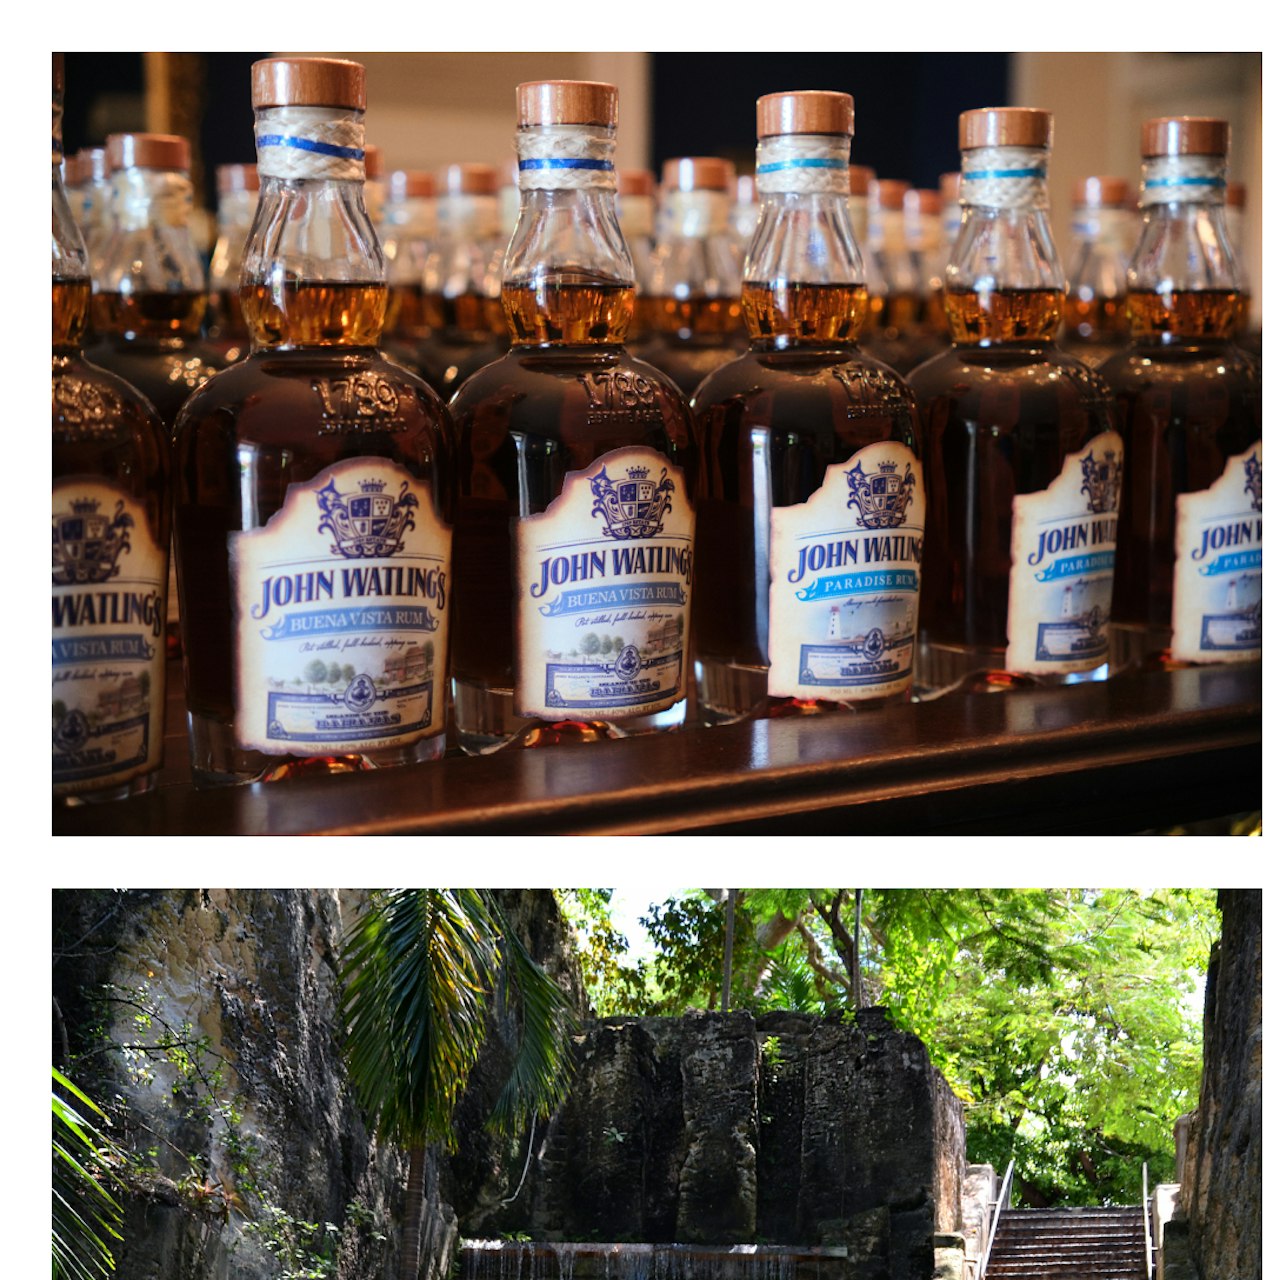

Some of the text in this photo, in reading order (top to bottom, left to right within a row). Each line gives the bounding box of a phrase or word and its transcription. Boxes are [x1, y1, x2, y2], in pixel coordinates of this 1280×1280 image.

[787, 535, 922, 583] JOHN WATLIN
[1027, 523, 1089, 566] JOHN
[1191, 520, 1253, 561] JOHN
[251, 565, 447, 620] JOHN WATLING'S
[530, 545, 692, 598] JOHN WATLING'S
[825, 575, 893, 592] PARADISE
[52, 590, 162, 637] WATLING'S
[567, 587, 677, 608] BUENA VISTA RUM
[291, 611, 423, 632] BUENA VISTA RUM
